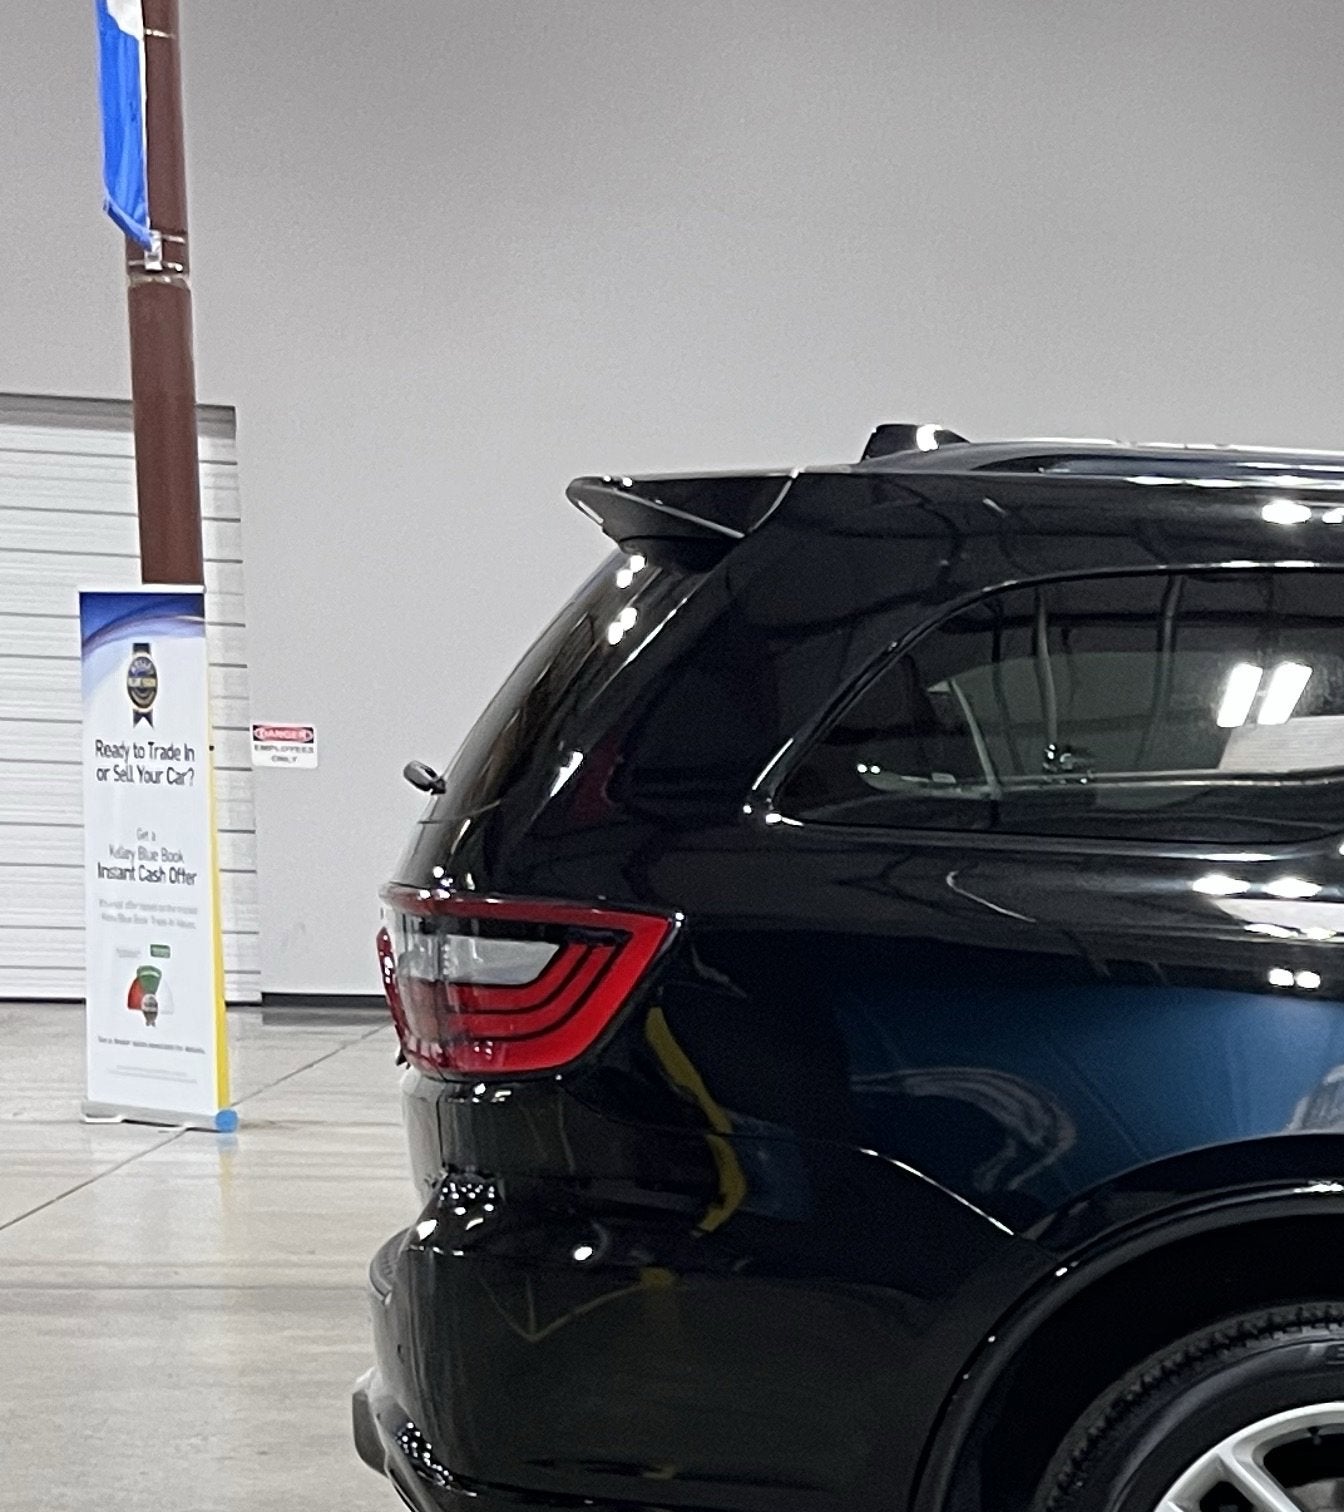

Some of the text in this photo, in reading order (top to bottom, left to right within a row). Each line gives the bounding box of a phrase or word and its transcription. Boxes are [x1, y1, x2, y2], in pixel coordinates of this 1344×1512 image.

[95, 739, 195, 763] Ready to Trade In
[96, 764, 194, 787] or Sell Your Car?
[138, 845, 159, 862] Blue
[161, 847, 184, 864] Book
[97, 862, 197, 886] Instant Cash Offer
